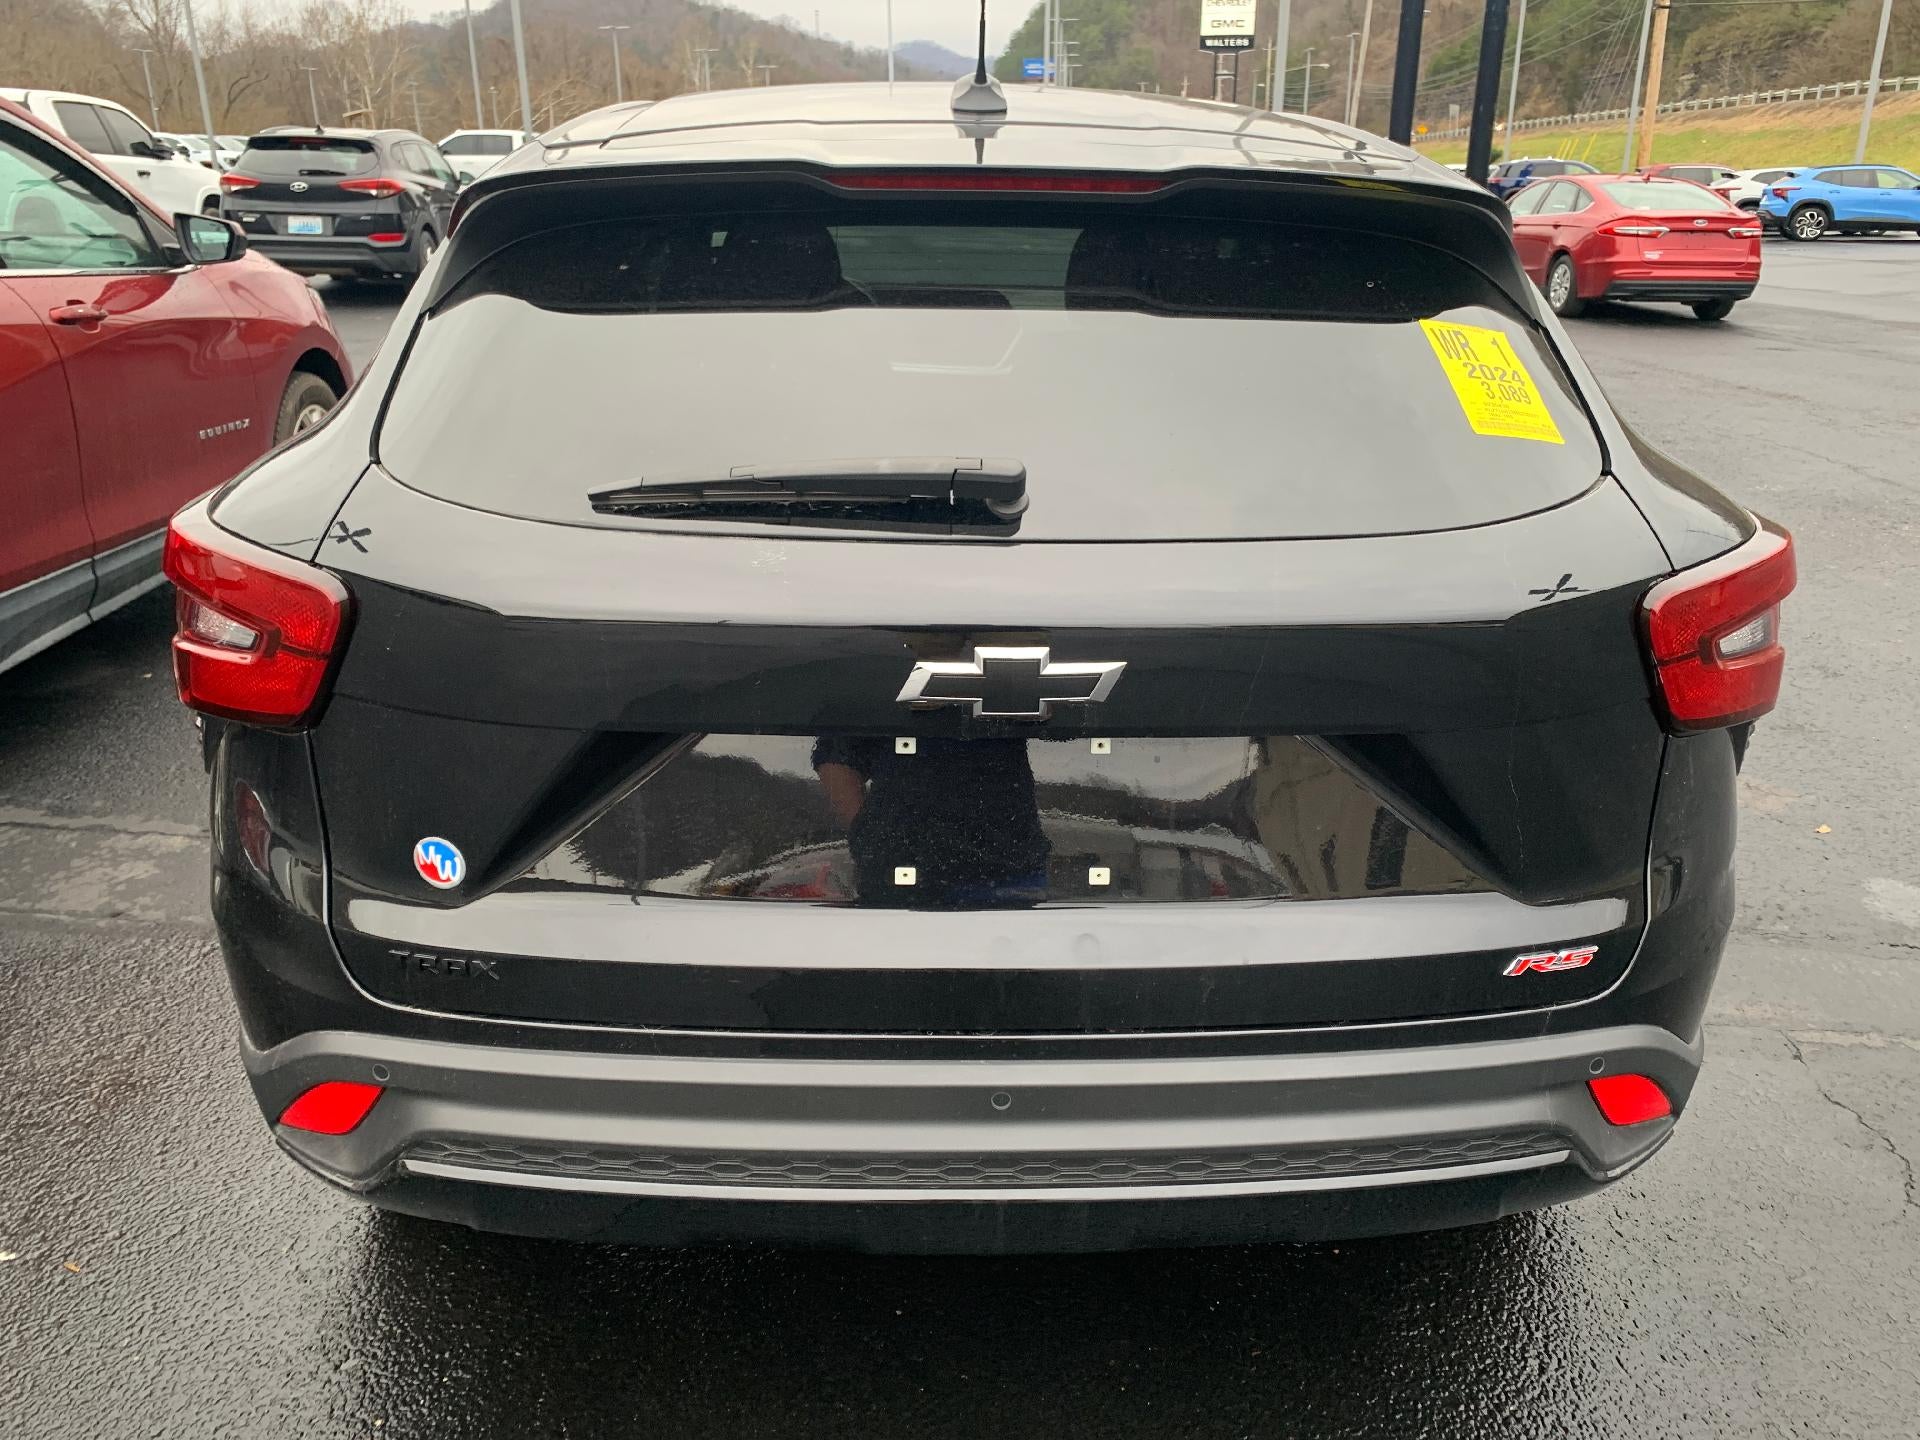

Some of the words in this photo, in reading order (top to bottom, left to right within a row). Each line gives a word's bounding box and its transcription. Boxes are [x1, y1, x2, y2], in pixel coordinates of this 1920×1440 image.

[1211, 20, 1245, 28] GMC
[1205, 39, 1249, 47] WALTERS
[1430, 328, 1480, 362] WR
[1491, 337, 1511, 368] 1
[1462, 362, 1525, 386] 2024
[1481, 381, 1531, 404] 3,089
[199, 418, 250, 440] EQUINOX
[388, 949, 500, 981] TRAX
[1502, 945, 1599, 976] RS
